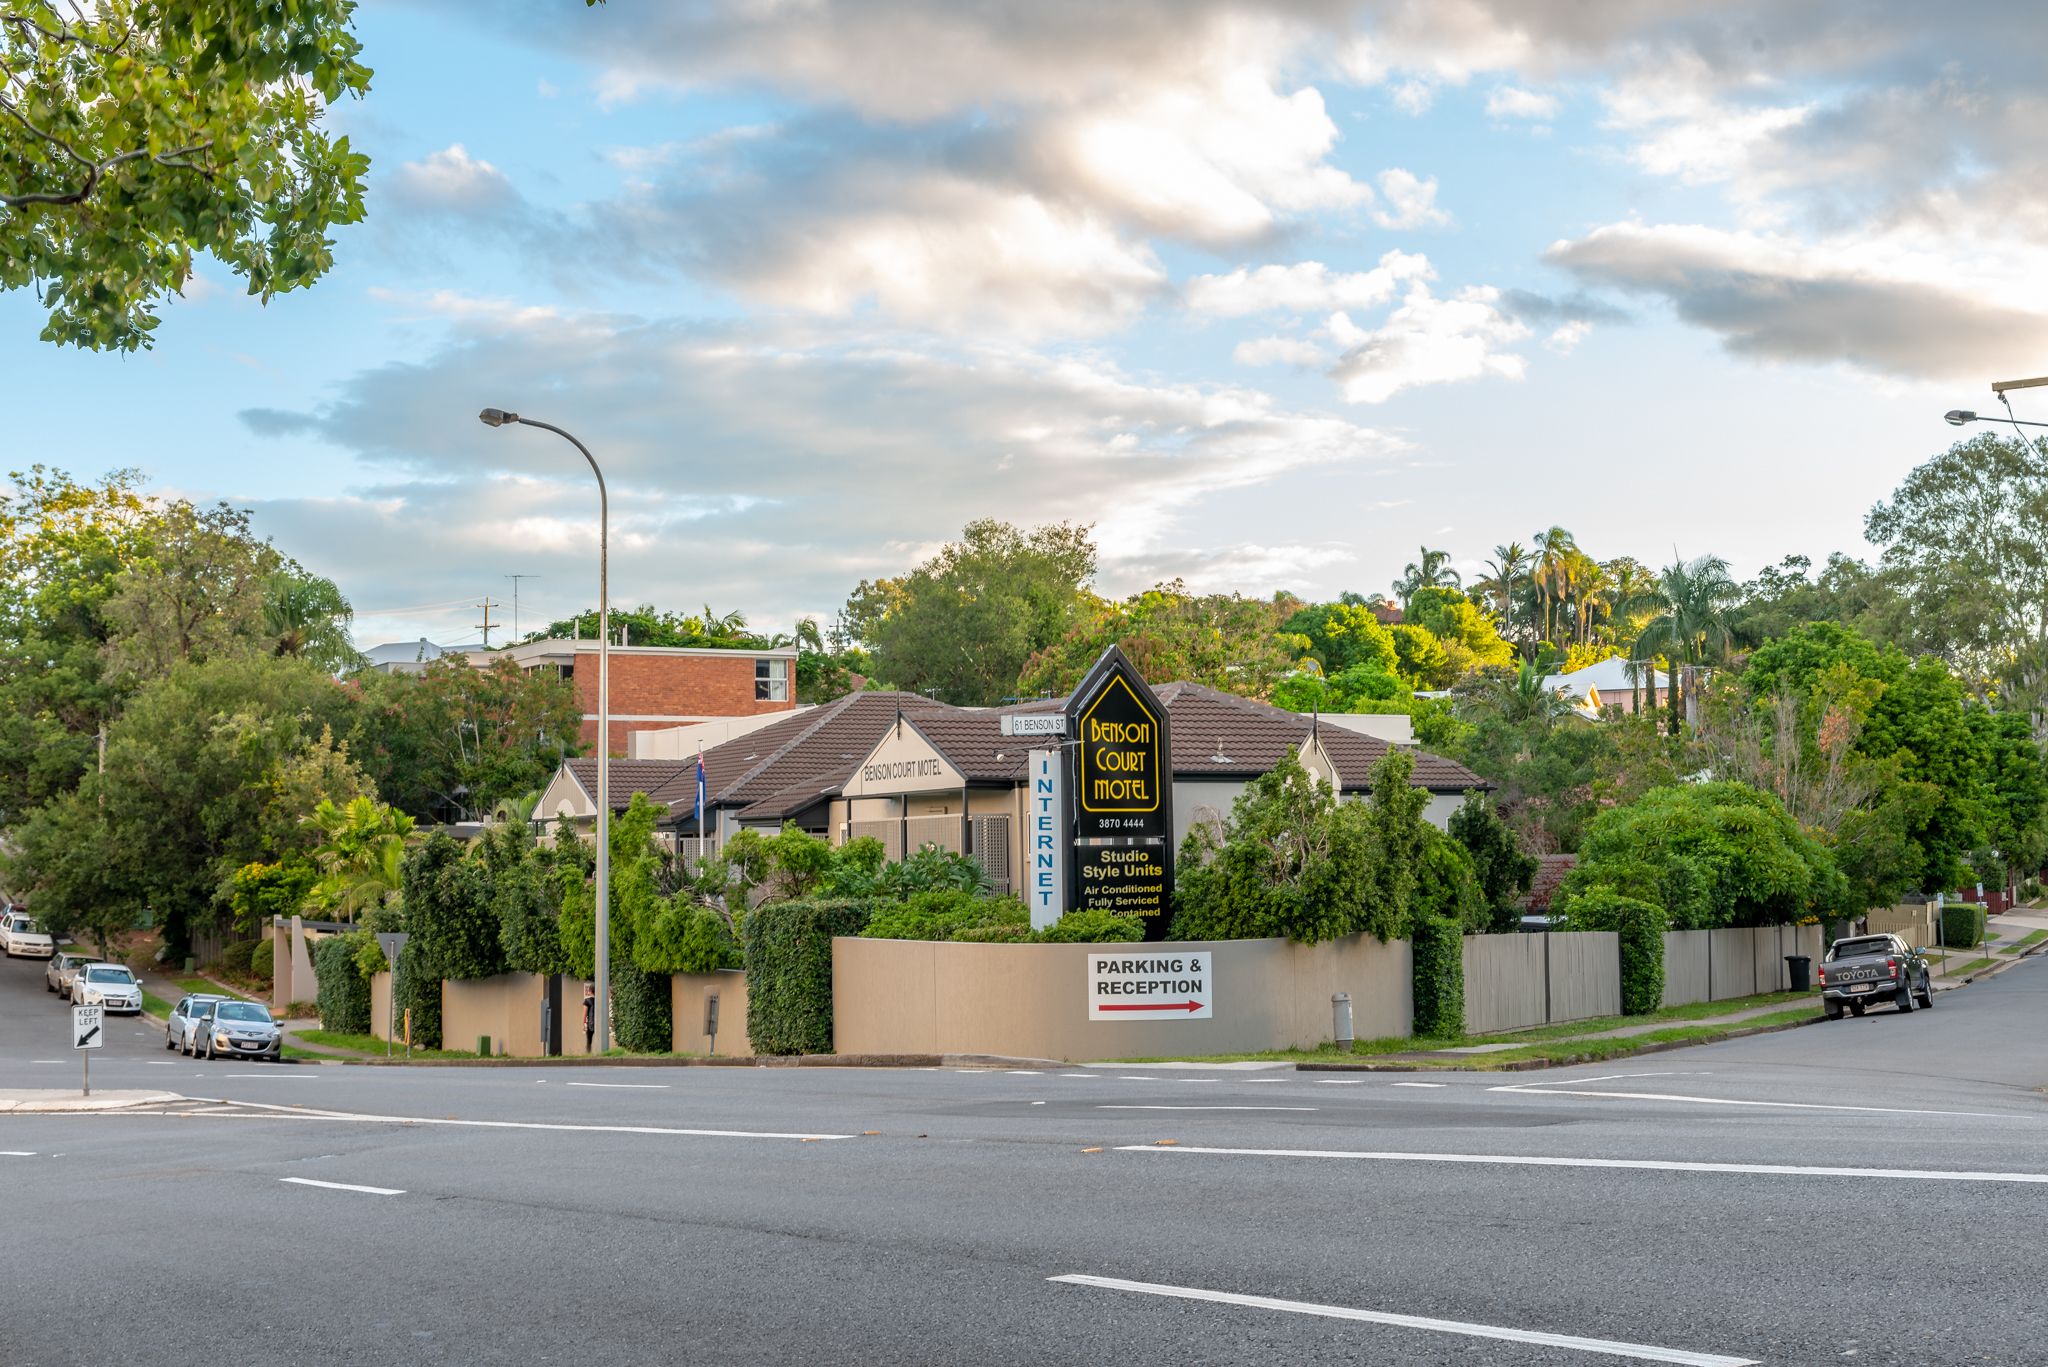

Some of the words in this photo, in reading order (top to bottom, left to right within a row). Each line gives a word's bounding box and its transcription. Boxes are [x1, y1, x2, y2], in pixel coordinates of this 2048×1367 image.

[1014, 720, 1023, 731] 61
[1024, 719, 1054, 731] BENSON
[1055, 719, 1065, 729] ST
[1091, 718, 1149, 743] BENSON
[1096, 747, 1146, 771] COURT
[864, 763, 892, 781] BENSON
[892, 761, 916, 778] COURT
[917, 759, 942, 777] MOTEL
[1094, 780, 1149, 800] MOTEL
[1099, 819, 1120, 828] 3870
[1123, 818, 1144, 828] 4444
[1037, 760, 1054, 905] INTERNET
[1100, 850, 1149, 863] Studio
[1083, 865, 1120, 880] Style
[1124, 864, 1163, 877] Units
[1084, 886, 1099, 895] Air
[1101, 884, 1163, 895] Conditioned
[1088, 898, 1113, 908] Fully
[1115, 896, 1159, 906] Serviced
[1110, 908, 1161, 918] Contained
[1097, 959, 1183, 974] PARKING
[1190, 959, 1202, 972] &
[1836, 968, 1879, 981] TOYOTA
[1097, 980, 1202, 995] RECEPTION
[78, 1008, 99, 1017] KEEP
[79, 1017, 97, 1025] LEFT
